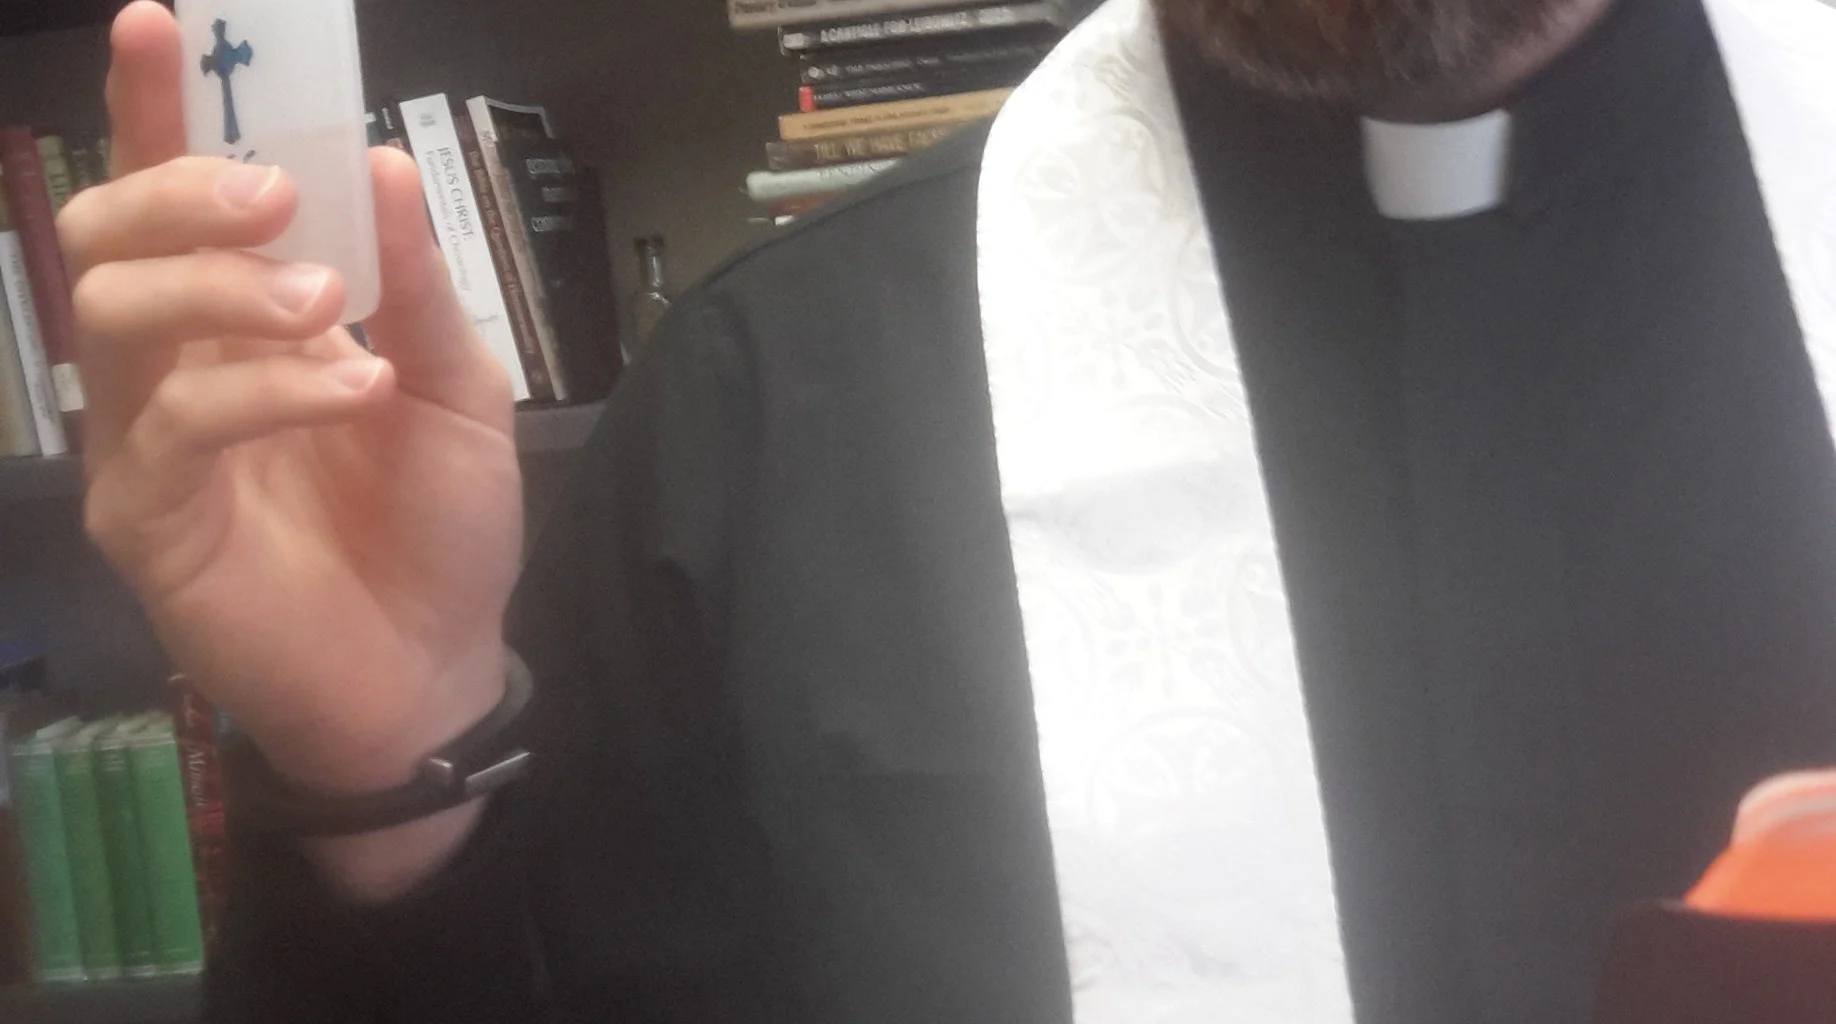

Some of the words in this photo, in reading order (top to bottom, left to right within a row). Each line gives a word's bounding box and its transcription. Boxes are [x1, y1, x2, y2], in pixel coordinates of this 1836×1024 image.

[436, 144, 461, 186] JESUS
[813, 140, 841, 162] TILL
[844, 136, 867, 156] WE
